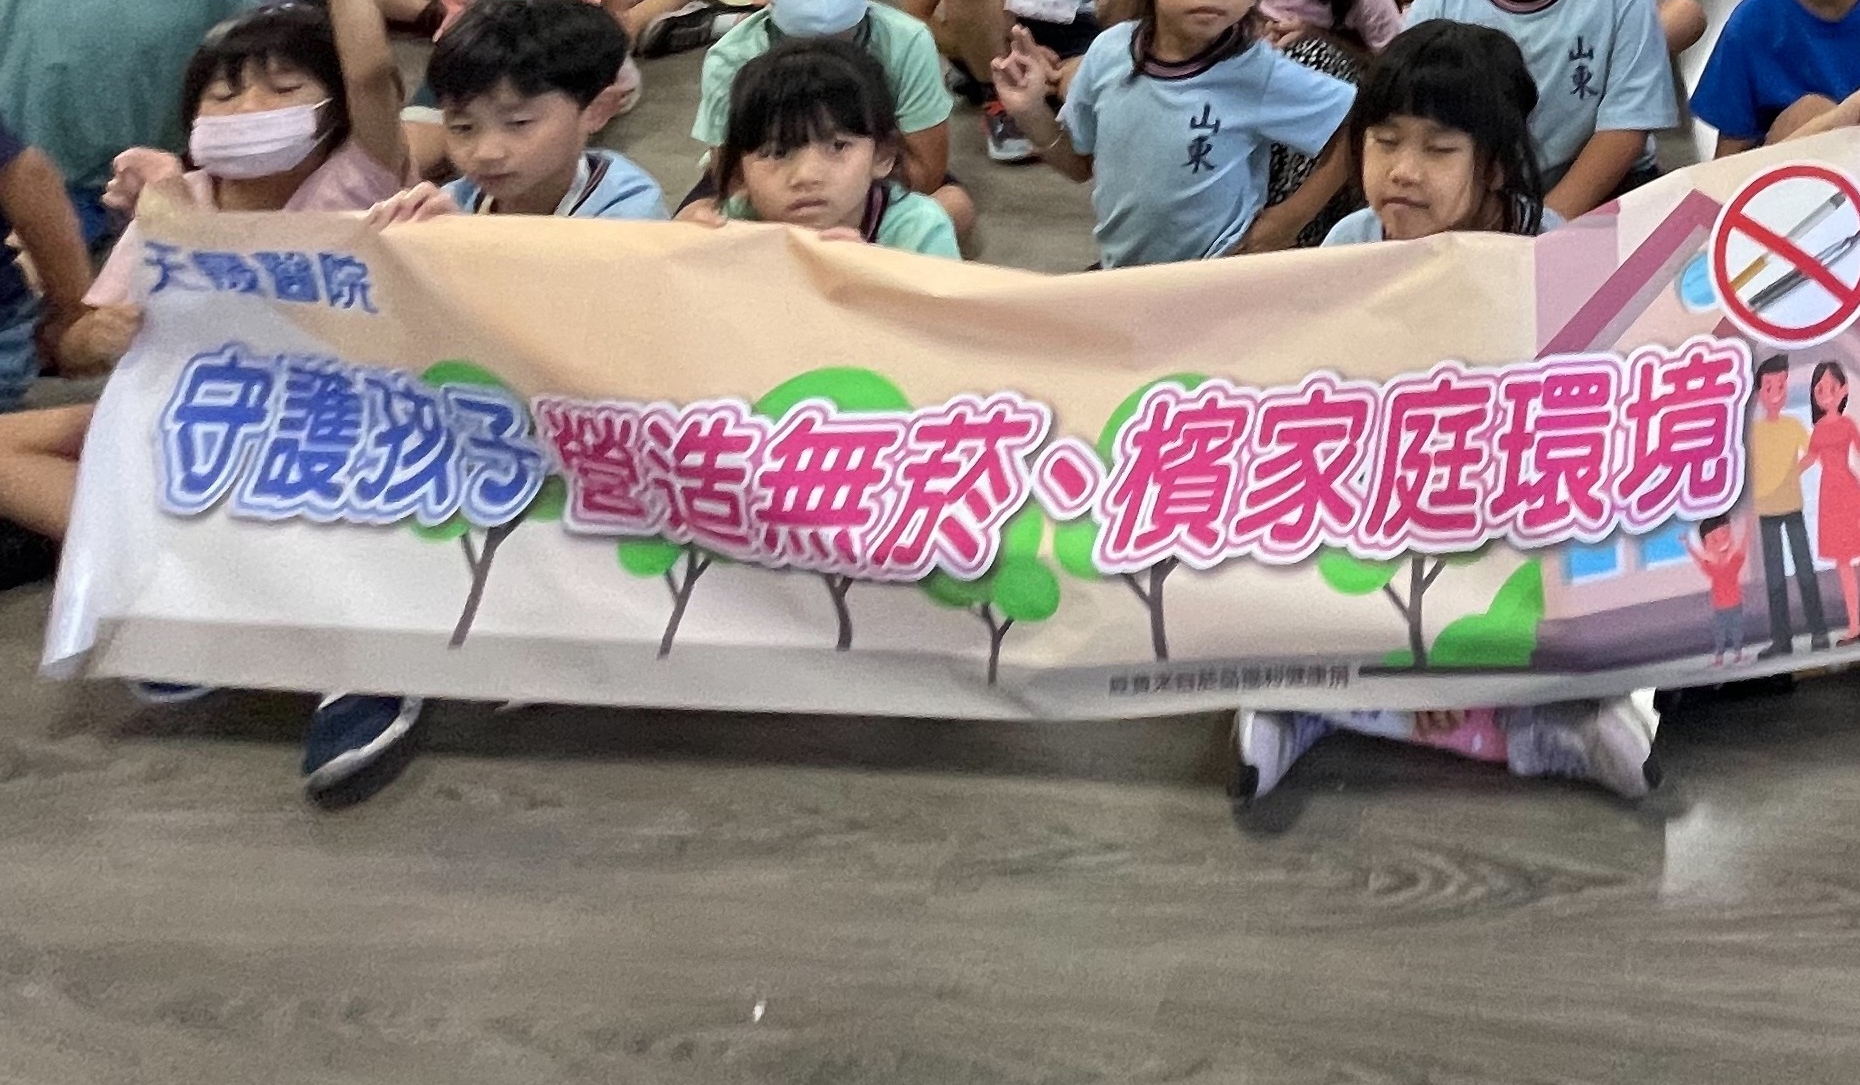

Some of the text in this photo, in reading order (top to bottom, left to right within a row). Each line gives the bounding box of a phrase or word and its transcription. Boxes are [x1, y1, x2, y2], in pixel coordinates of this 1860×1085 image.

[1568, 35, 1599, 100] 山東
[1181, 102, 1221, 174] 山東
[166, 344, 1750, 576] 守護孩子 營造無菸、檳家庭環境
